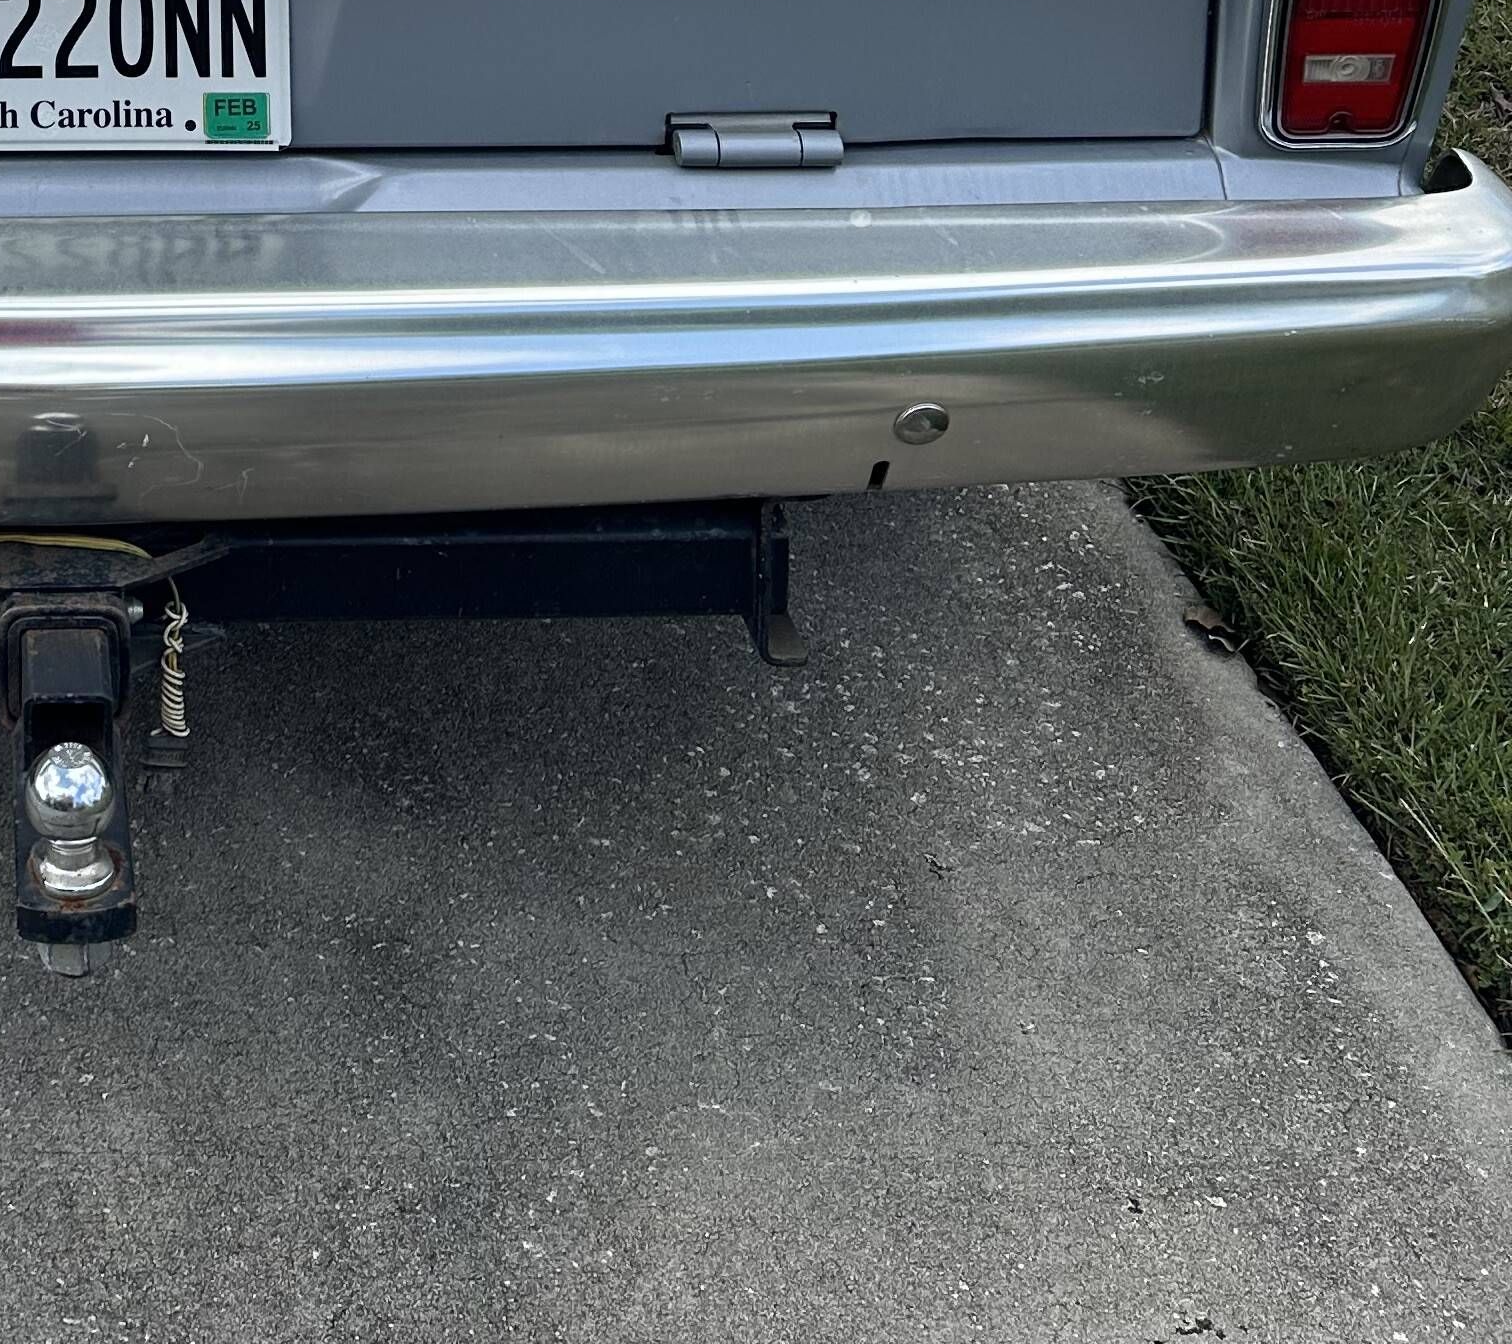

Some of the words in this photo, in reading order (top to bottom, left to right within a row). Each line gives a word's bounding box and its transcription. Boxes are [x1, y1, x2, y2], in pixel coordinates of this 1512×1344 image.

[30, 99, 174, 130] Carolina
[214, 98, 258, 117] FEB
[247, 120, 261, 132] 25
